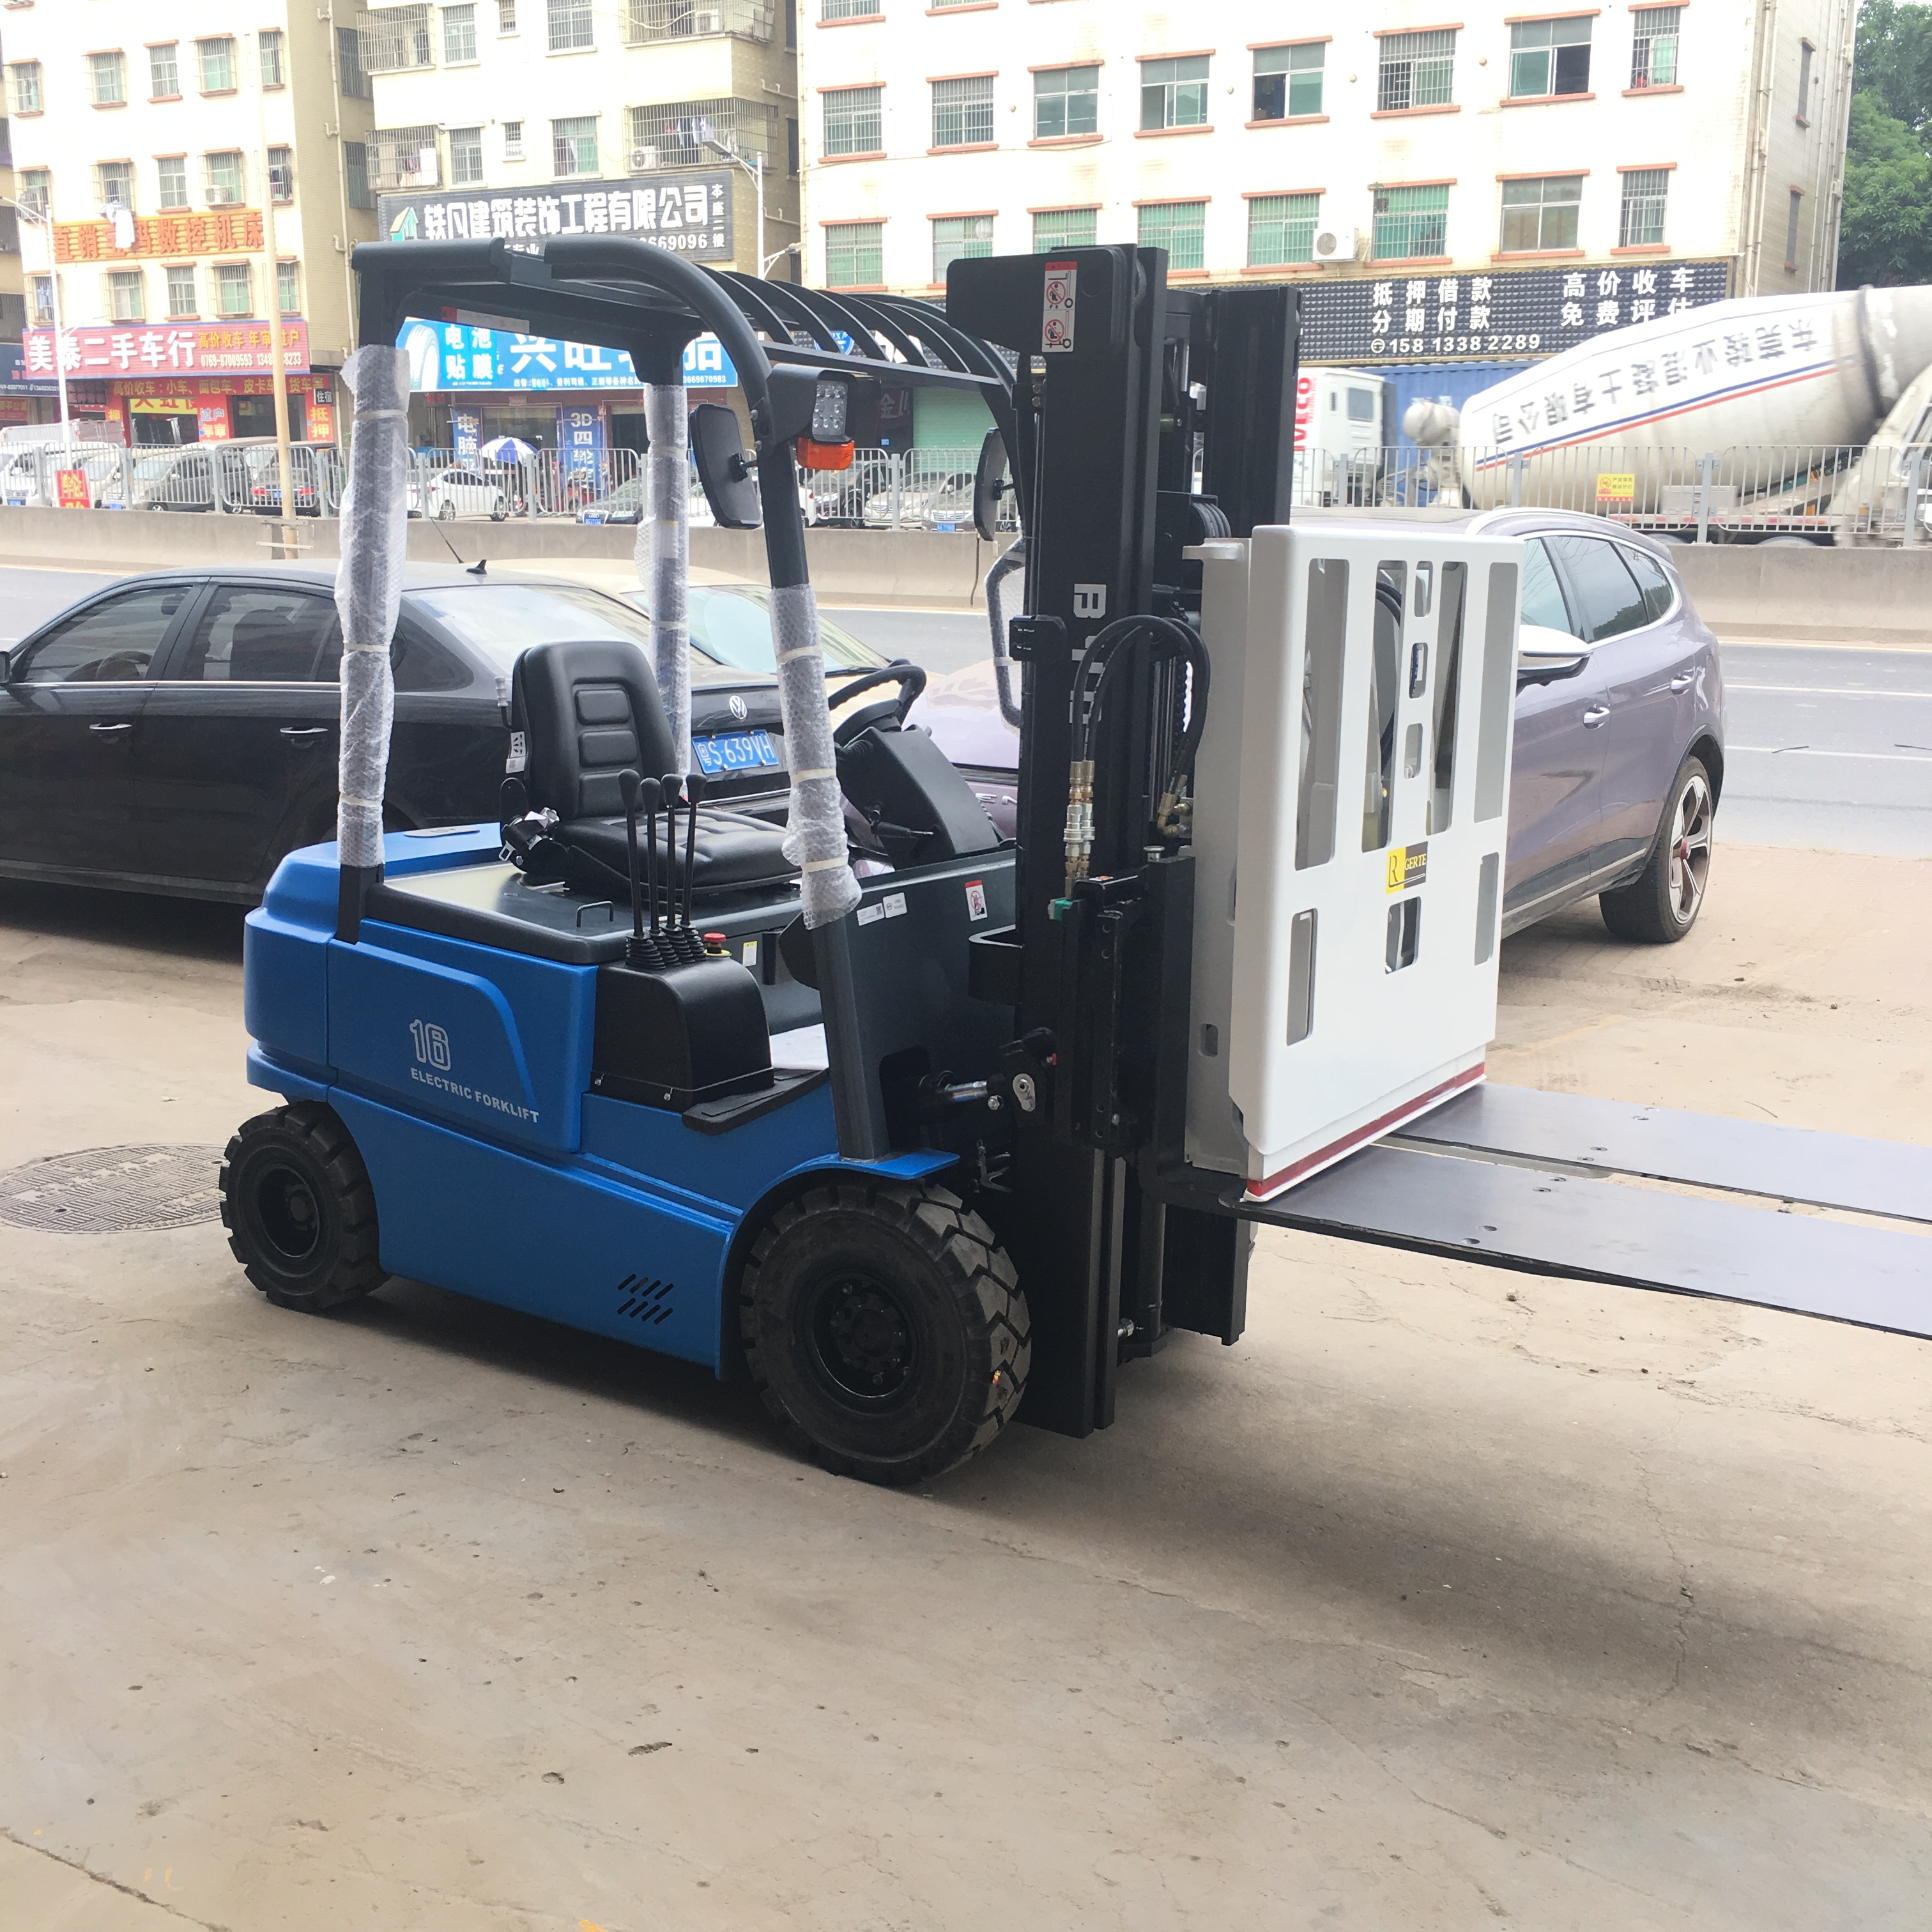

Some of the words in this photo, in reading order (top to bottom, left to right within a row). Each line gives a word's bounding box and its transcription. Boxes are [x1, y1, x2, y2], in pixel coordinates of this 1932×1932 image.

[1373, 277, 1492, 307] 抵押借款
[1563, 268, 1694, 298] 高价收车
[1372, 307, 1491, 334] 分期付款
[28, 330, 195, 372] 美泰二手车行
[198, 330, 244, 349] 高价收车
[445, 323, 493, 349] 电池
[1389, 339, 1423, 353] 158
[1432, 336, 1482, 352] 1338
[1487, 334, 1540, 350] 2289
[201, 353, 253, 368] 0769-87009593
[257, 351, 302, 366] 13488233
[446, 353, 494, 380] 贴膜
[510, 332, 722, 373] 兴旺胎
[316, 391, 333, 403] 住宿
[310, 407, 329, 441] 抵押
[1293, 378, 1310, 452] IVECO
[410, 1019, 451, 1071] 16
[410, 1068, 472, 1099] ELECTRIC
[474, 1091, 539, 1123] FORKLIFT
